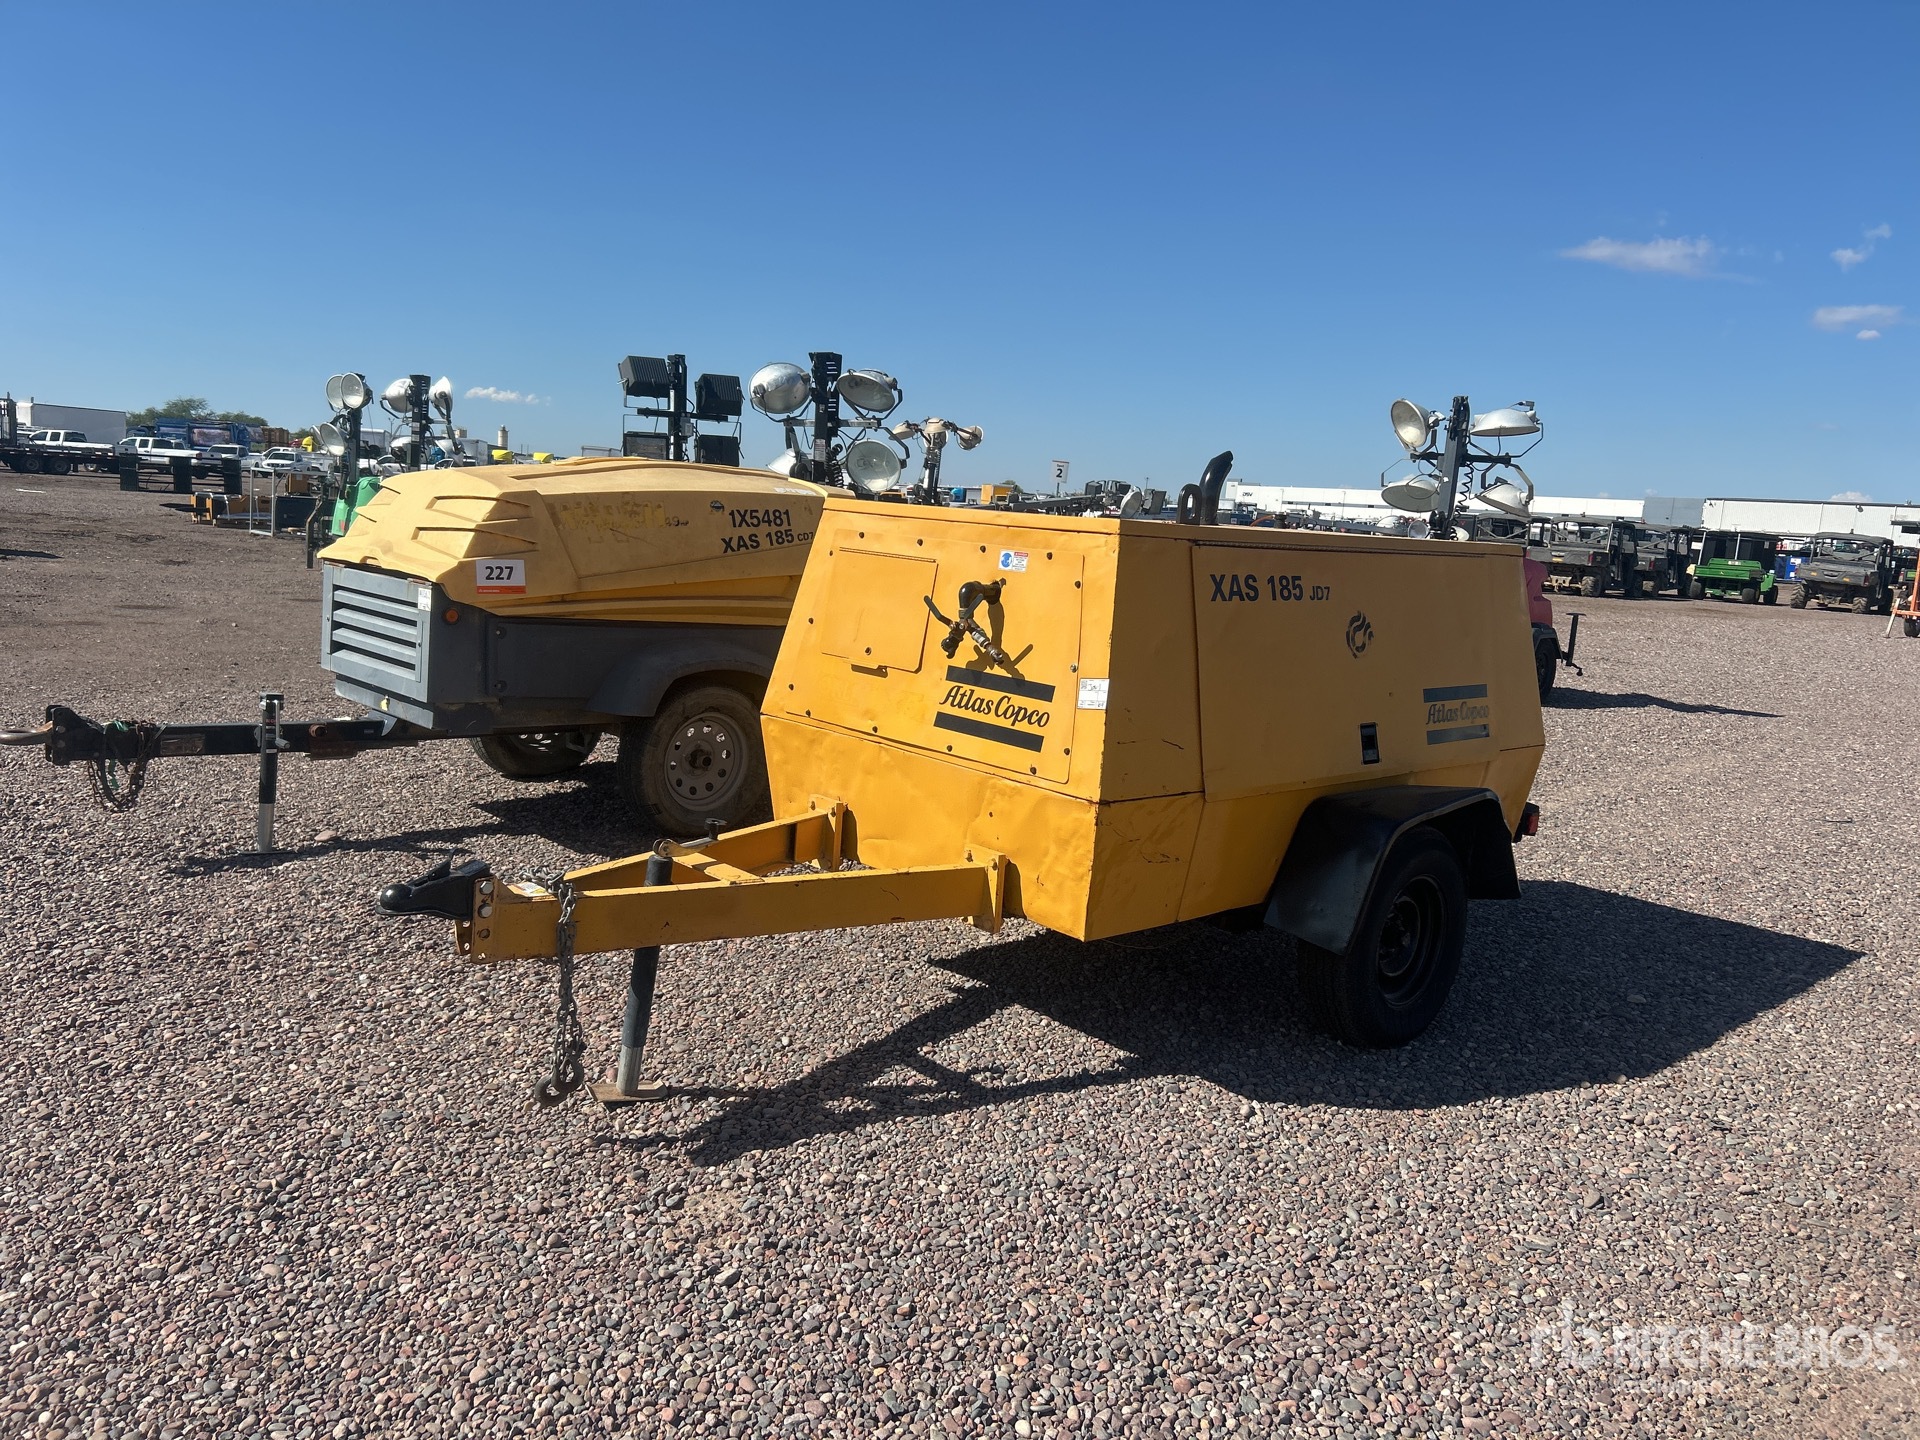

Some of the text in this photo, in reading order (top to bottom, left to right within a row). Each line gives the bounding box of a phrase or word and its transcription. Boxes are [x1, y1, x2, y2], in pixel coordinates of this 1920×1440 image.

[1056, 468, 1063, 478] 2
[729, 509, 791, 528] 1X5481
[721, 529, 814, 553] XAS 185 CD7
[485, 565, 514, 580] 227
[1210, 574, 1330, 601] XAS 185 JD7
[939, 685, 1050, 727] Atlas Copco
[1426, 703, 1459, 725] Atlas
